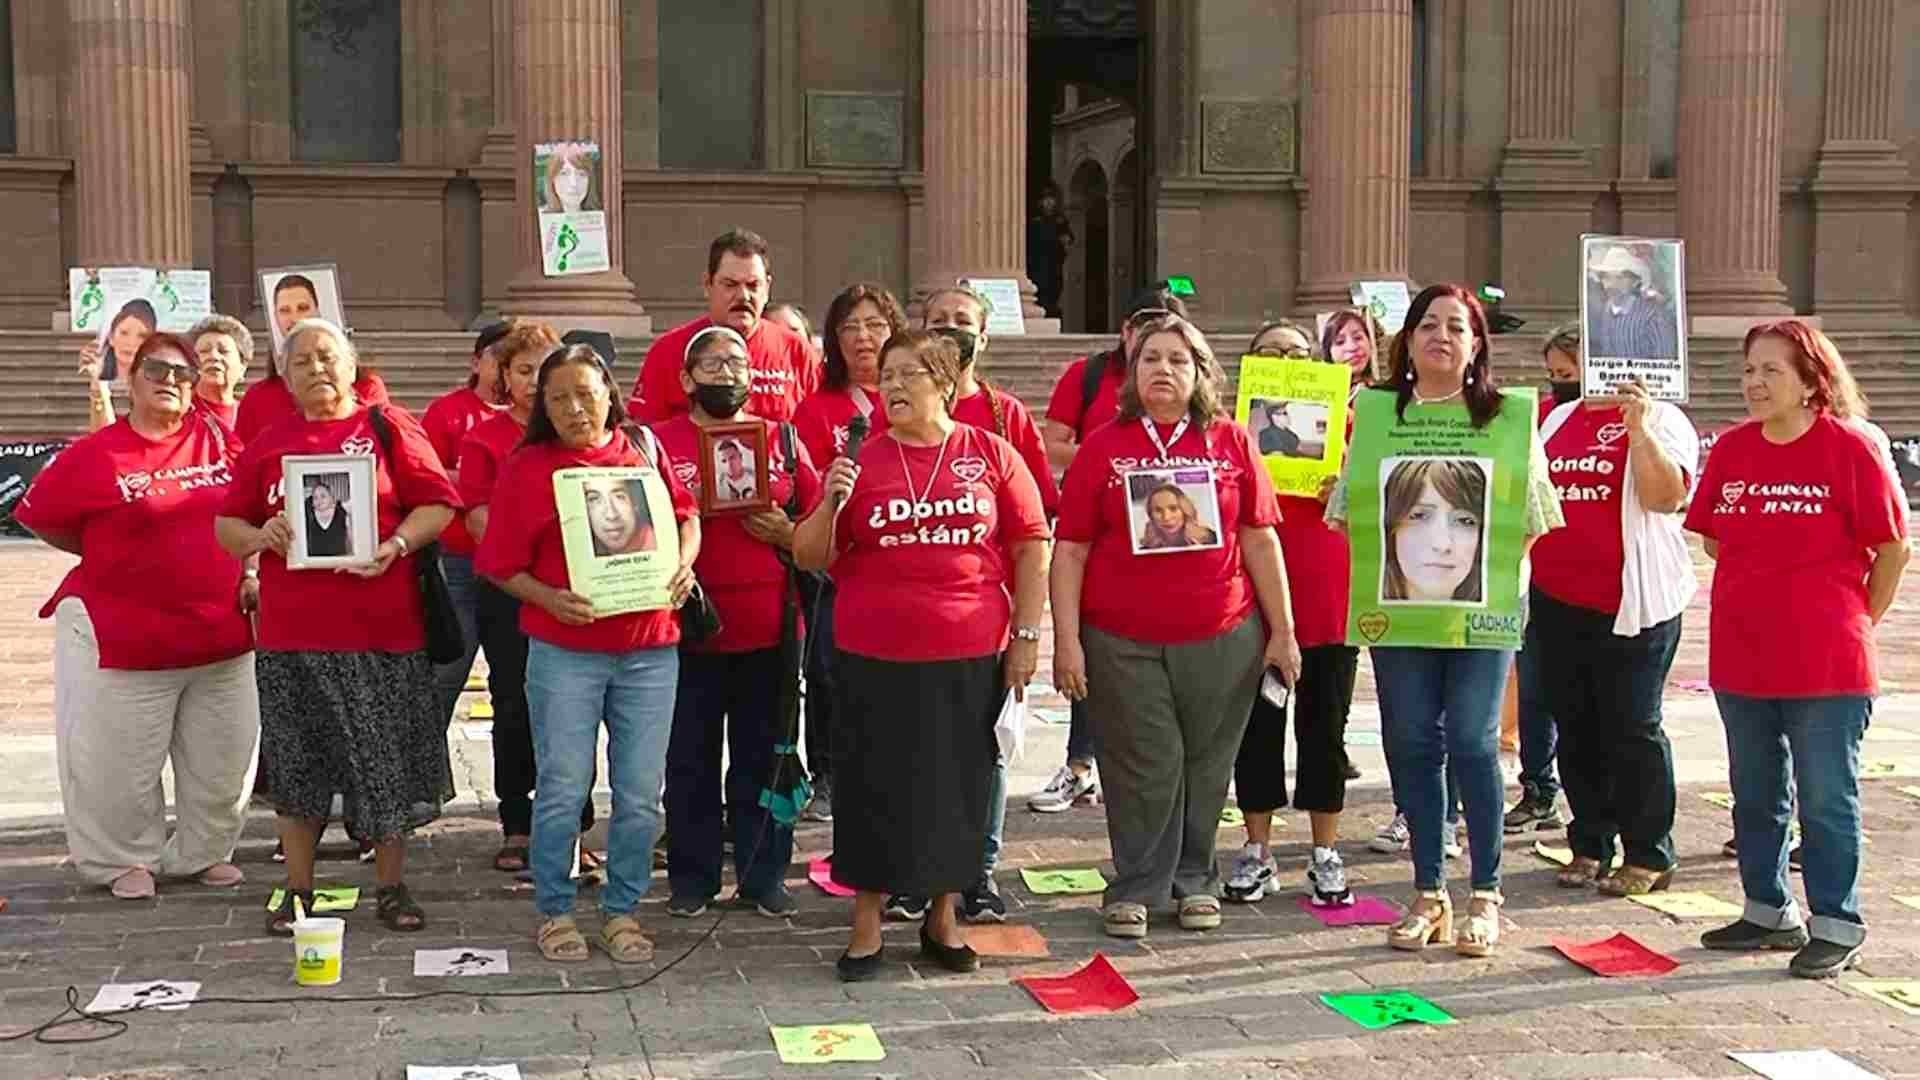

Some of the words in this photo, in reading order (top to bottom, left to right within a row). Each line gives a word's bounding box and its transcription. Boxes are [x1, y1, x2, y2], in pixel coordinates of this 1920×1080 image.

[1588, 360, 1624, 369] Jorge
[1626, 360, 1681, 370] Armando
[1550, 455, 1614, 475] ónde
[1556, 483, 1611, 501] tán?
[1761, 500, 1823, 514] JUNTAS
[879, 523, 988, 547] están?
[1471, 613, 1518, 633] CADHAC
